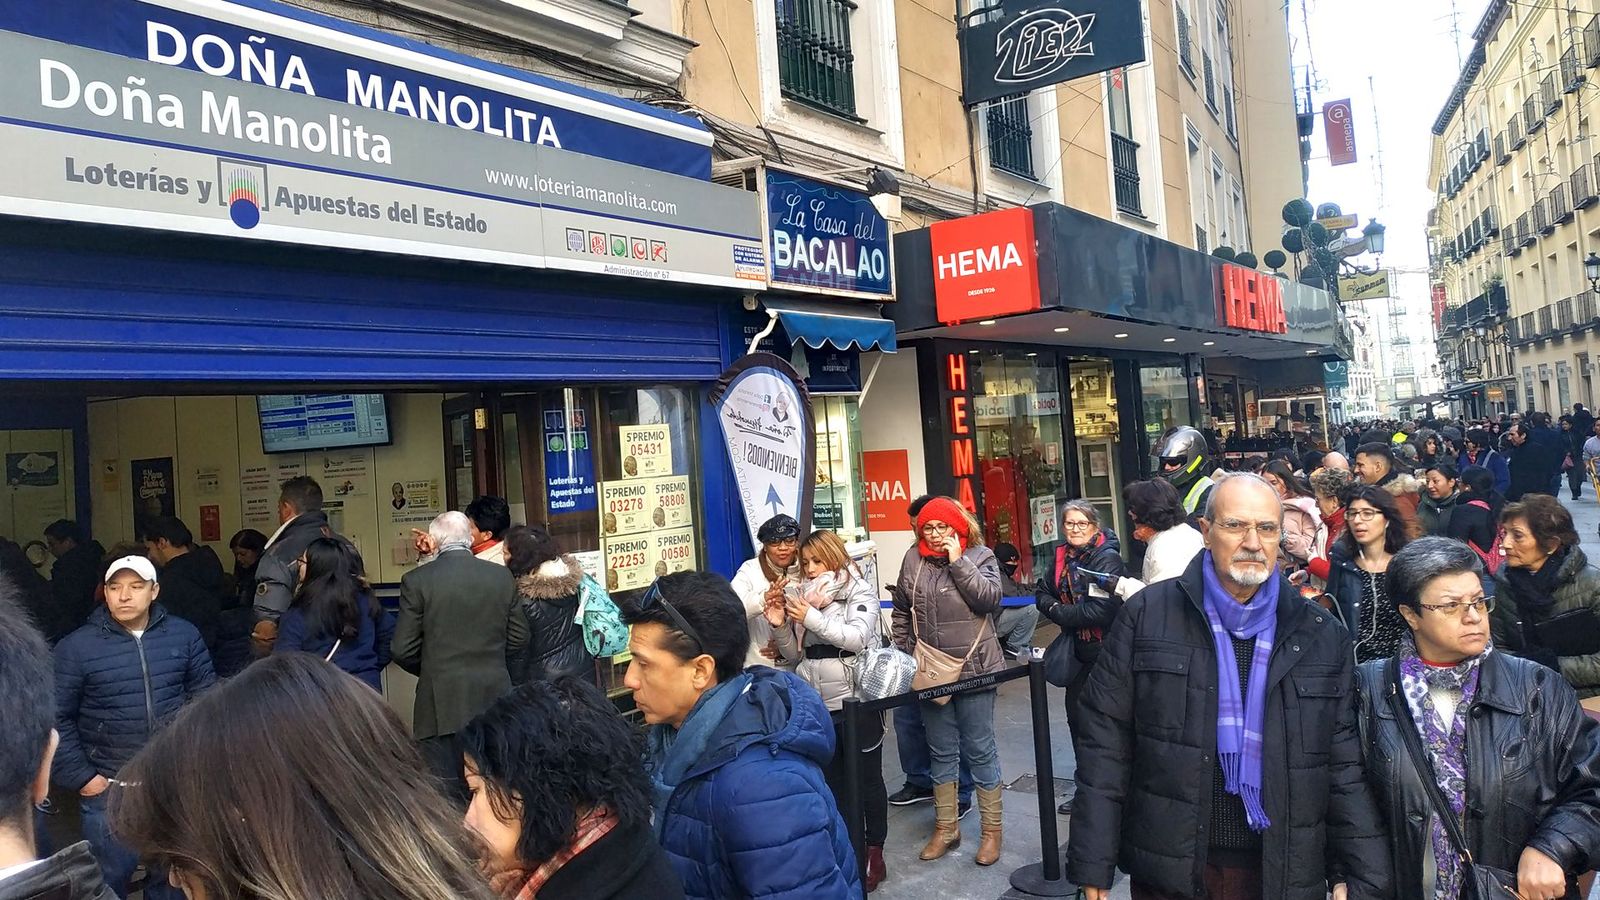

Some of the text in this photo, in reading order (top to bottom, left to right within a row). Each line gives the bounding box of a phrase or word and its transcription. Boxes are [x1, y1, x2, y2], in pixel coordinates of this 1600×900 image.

[146, 20, 562, 148] DOÑA MANOLITA
[39, 58, 392, 165] Doña Manolita
[1342, 117, 1354, 152] asnepa
[65, 157, 488, 234] Loterías y Apuestas del Estado
[485, 168, 678, 216] www.loteriamanolita.com
[782, 193, 876, 241] La Casa del
[603, 265, 652, 278] Administración
[773, 229, 885, 280] BACALAO
[937, 242, 1023, 280] HEMA
[1222, 263, 1288, 335] HEMA
[630, 442, 662, 456] 05431
[948, 353, 976, 514] HEMA
[549, 477, 578, 486] Loterías
[550, 486, 595, 498] Apuestas del
[864, 480, 907, 501] EMA
[551, 499, 575, 509] Estado
[610, 497, 643, 513] 03278
[611, 553, 645, 569] 22253
[661, 545, 690, 560] 00580
